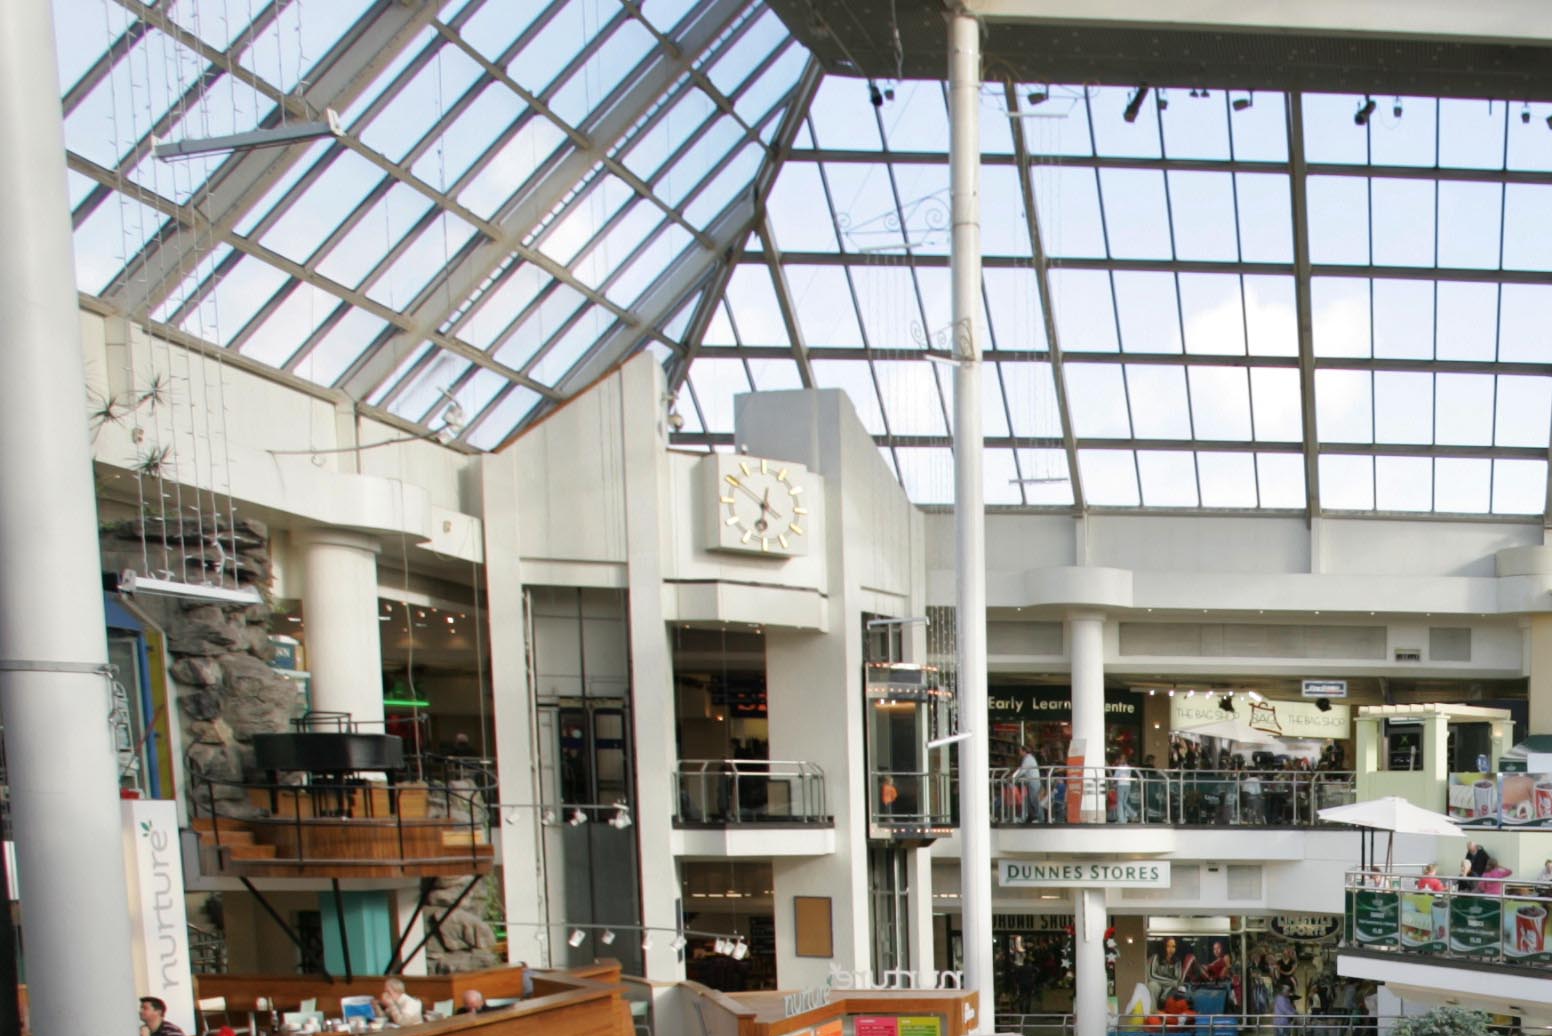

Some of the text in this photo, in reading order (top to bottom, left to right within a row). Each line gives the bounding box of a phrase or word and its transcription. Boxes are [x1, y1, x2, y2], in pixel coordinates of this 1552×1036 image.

[988, 696, 1136, 714] Early Learn entre
[1176, 707, 1240, 721] THE BAG SHOP
[1288, 714, 1346, 728] THE BAG SHOP
[1007, 864, 1160, 881] DUNNES STORES
[150, 829, 180, 990] nurture
[784, 985, 832, 1018] nurture
